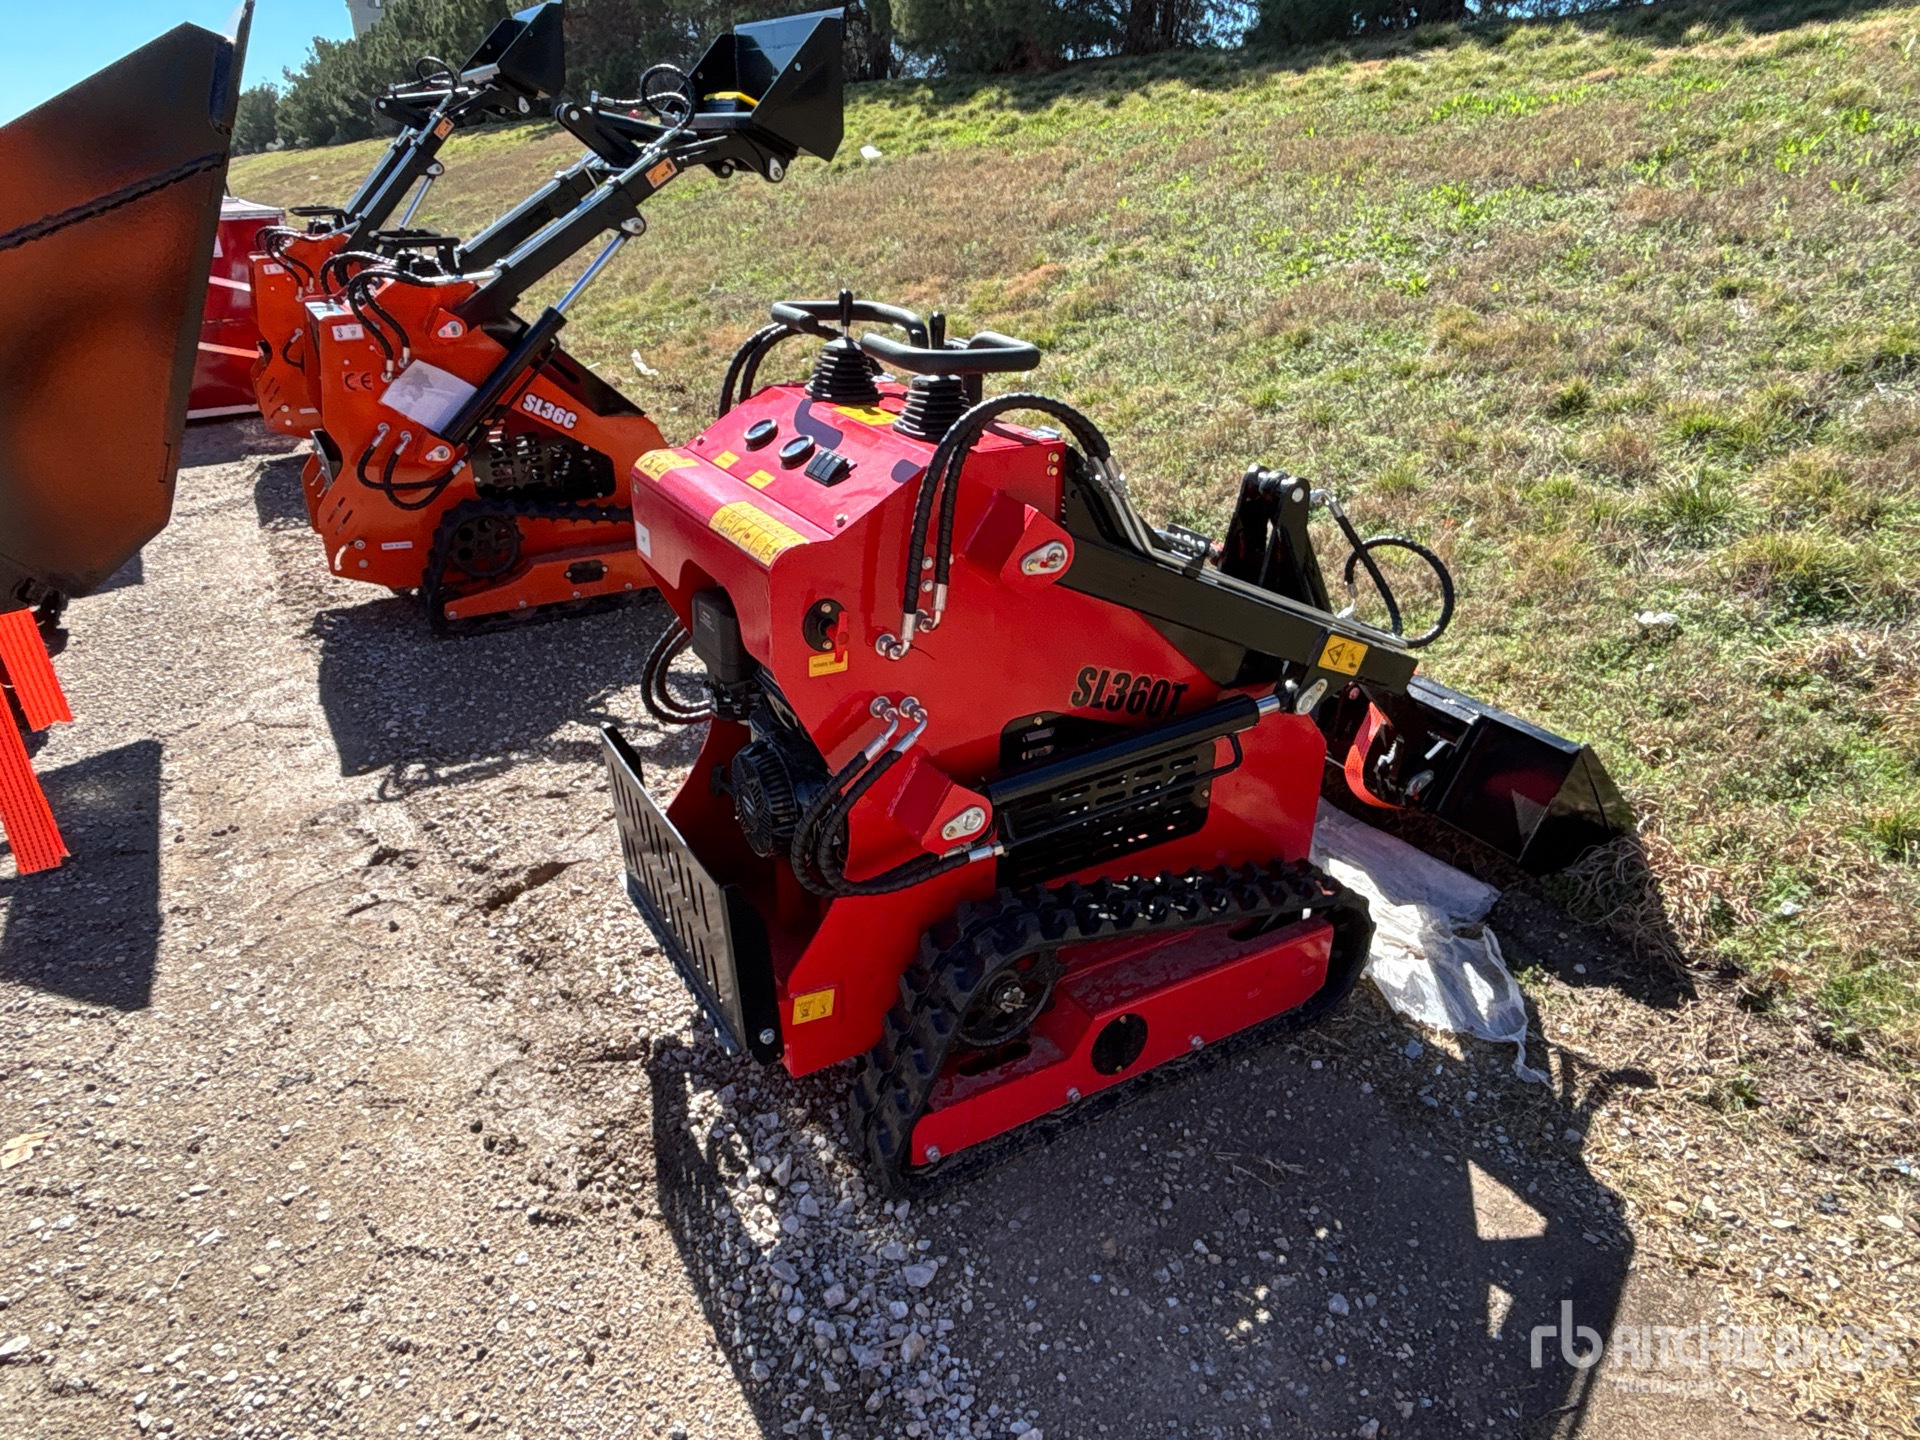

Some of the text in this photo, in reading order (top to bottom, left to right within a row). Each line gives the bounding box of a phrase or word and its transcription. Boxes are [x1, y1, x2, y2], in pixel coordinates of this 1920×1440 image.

[344, 372, 373, 391] CE
[522, 393, 578, 430] SL36C
[1071, 666, 1190, 718] SL360T
